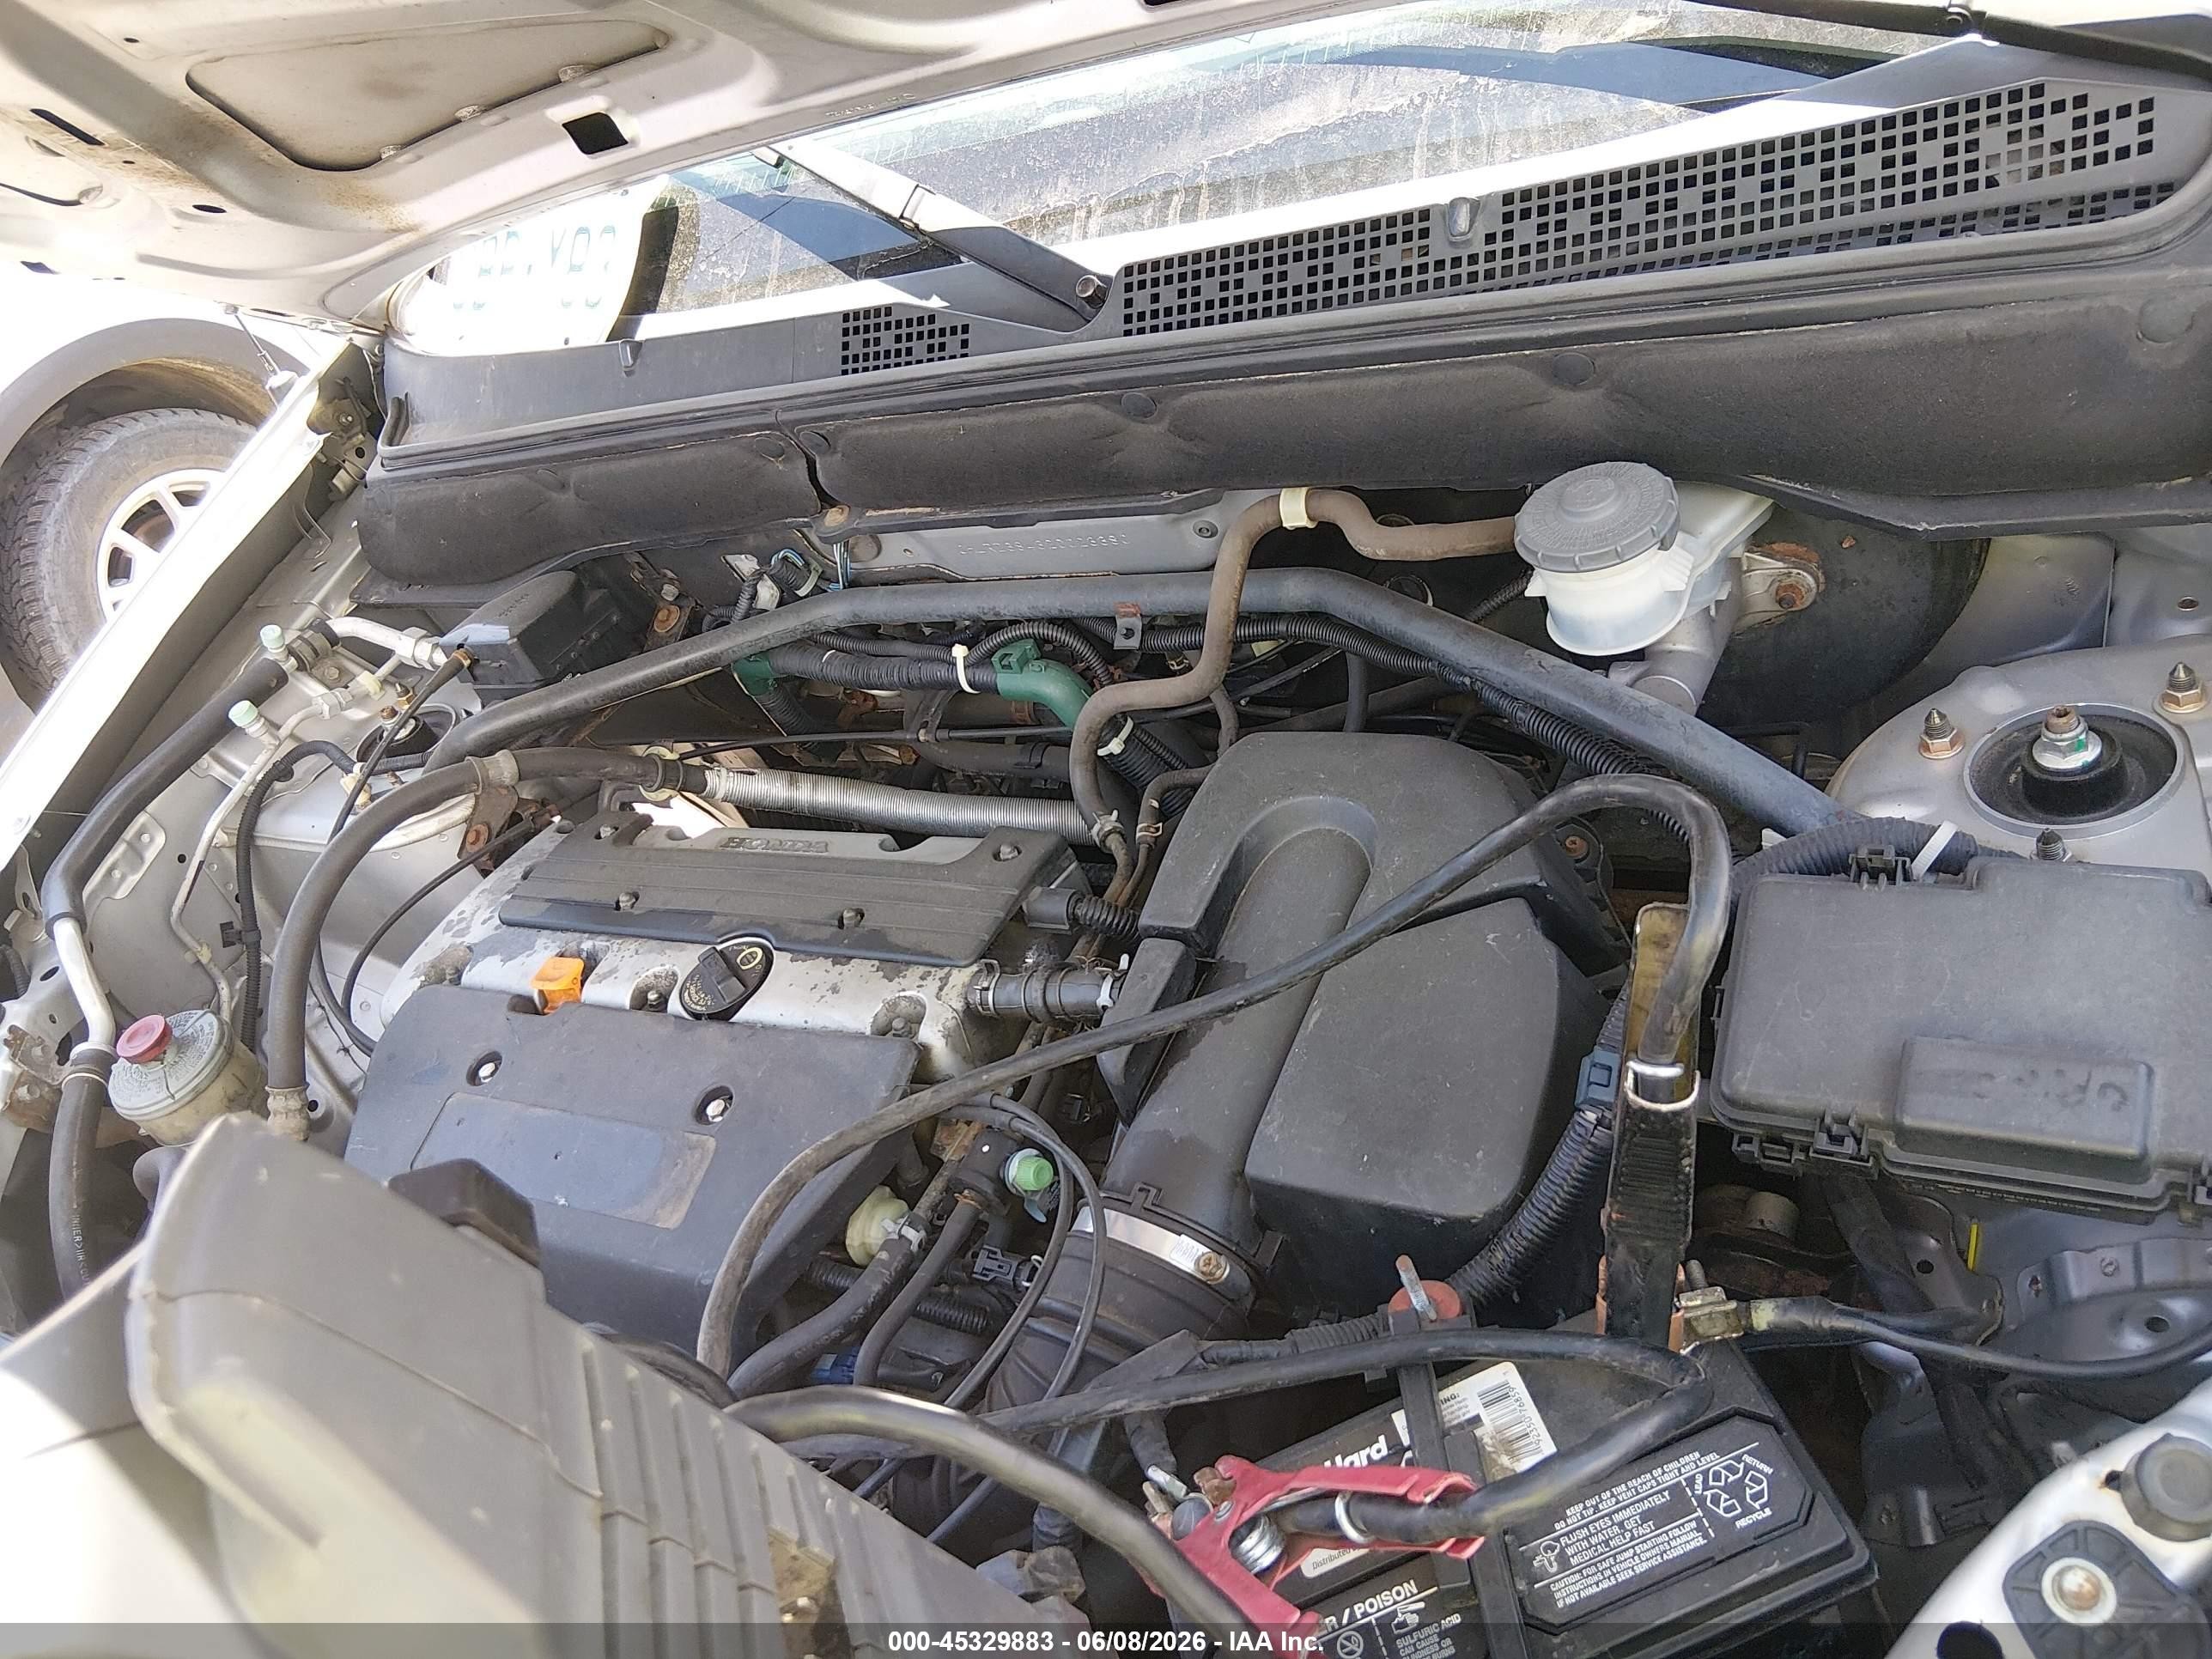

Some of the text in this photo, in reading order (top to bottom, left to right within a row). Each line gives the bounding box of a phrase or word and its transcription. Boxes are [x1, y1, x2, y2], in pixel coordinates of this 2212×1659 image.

[1440, 1392, 1460, 1406] ING:
[1565, 1451, 1701, 1517] KEEP OUT OF THE REACH OF CHILDREN
[1694, 1474, 1703, 1495] LEAD
[1741, 1454, 1774, 1474] RETURN
[1553, 1520, 1566, 1530] DO
[1565, 1512, 1582, 1526] NOT
[1597, 1497, 1617, 1510] KEEP
[1616, 1487, 1637, 1502] VENT
[1637, 1479, 1657, 1493] CAPS
[1656, 1468, 1680, 1484] TIGHT
[1680, 1462, 1697, 1474] AND
[1696, 1452, 1721, 1467] LEVEL
[1559, 1490, 1670, 1547] FLUSH EYES IMMEDIATELY
[1565, 1539, 1590, 1557] WITH
[1623, 1514, 1642, 1530] GET
[1735, 1507, 1772, 1529] RECYCLE
[1550, 1520, 1698, 1591] CAUTION: FOR SAFE JUMP STARTING FOLLOW
[1569, 1520, 1656, 1566] MEDICAL HELP FAST
[1553, 1571, 1604, 1601] INSTRUCTIONS
[1602, 1568, 1612, 1578] IN
[1610, 1555, 1642, 1574] VEHICLE
[1639, 1542, 1671, 1561] OWNERS
[1556, 1598, 1565, 1608] IF
[1564, 1591, 1580, 1606] NOT
[1579, 1575, 1617, 1599] AVAILABLE
[1615, 1568, 1635, 1583] SEEK
[1633, 1554, 1663, 1574] SERVICE
[1352, 1579, 1419, 1620] POISON
[1395, 1613, 1462, 1649] SULFURIC ACID
[1399, 1633, 1440, 1656] CAN CAUSE
[1440, 1637, 1452, 1648] OR
